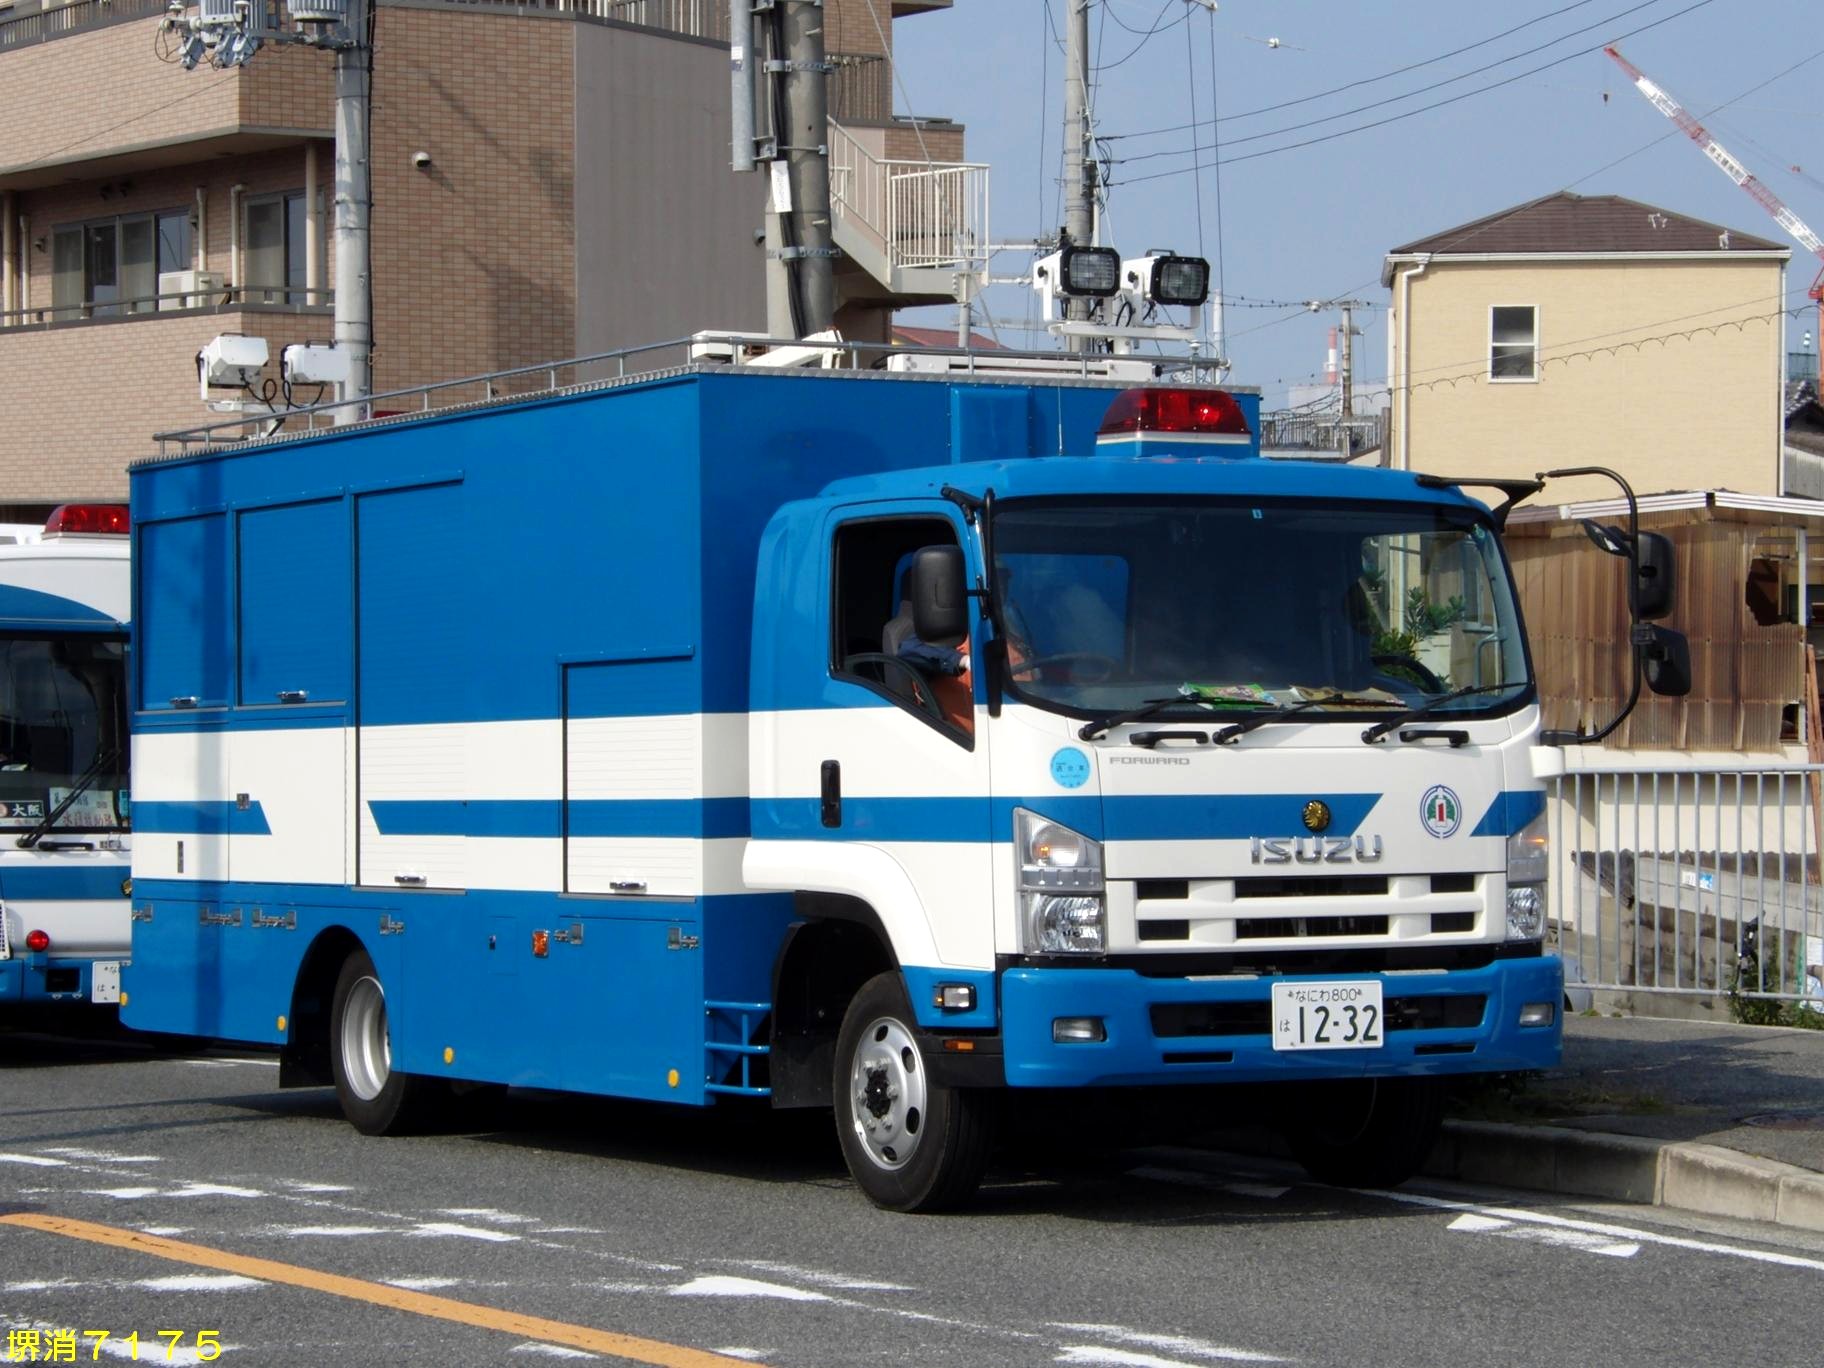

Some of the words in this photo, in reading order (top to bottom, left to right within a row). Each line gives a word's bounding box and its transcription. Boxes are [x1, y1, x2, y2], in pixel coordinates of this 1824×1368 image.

[1109, 756, 1191, 765] FORWARD
[12, 803, 42, 817] 大阪
[1250, 834, 1382, 865] ISUZU
[1295, 987, 1357, 1003] なにわ800
[1280, 1019, 1291, 1033] は
[1299, 1004, 1378, 1043] 12-32
